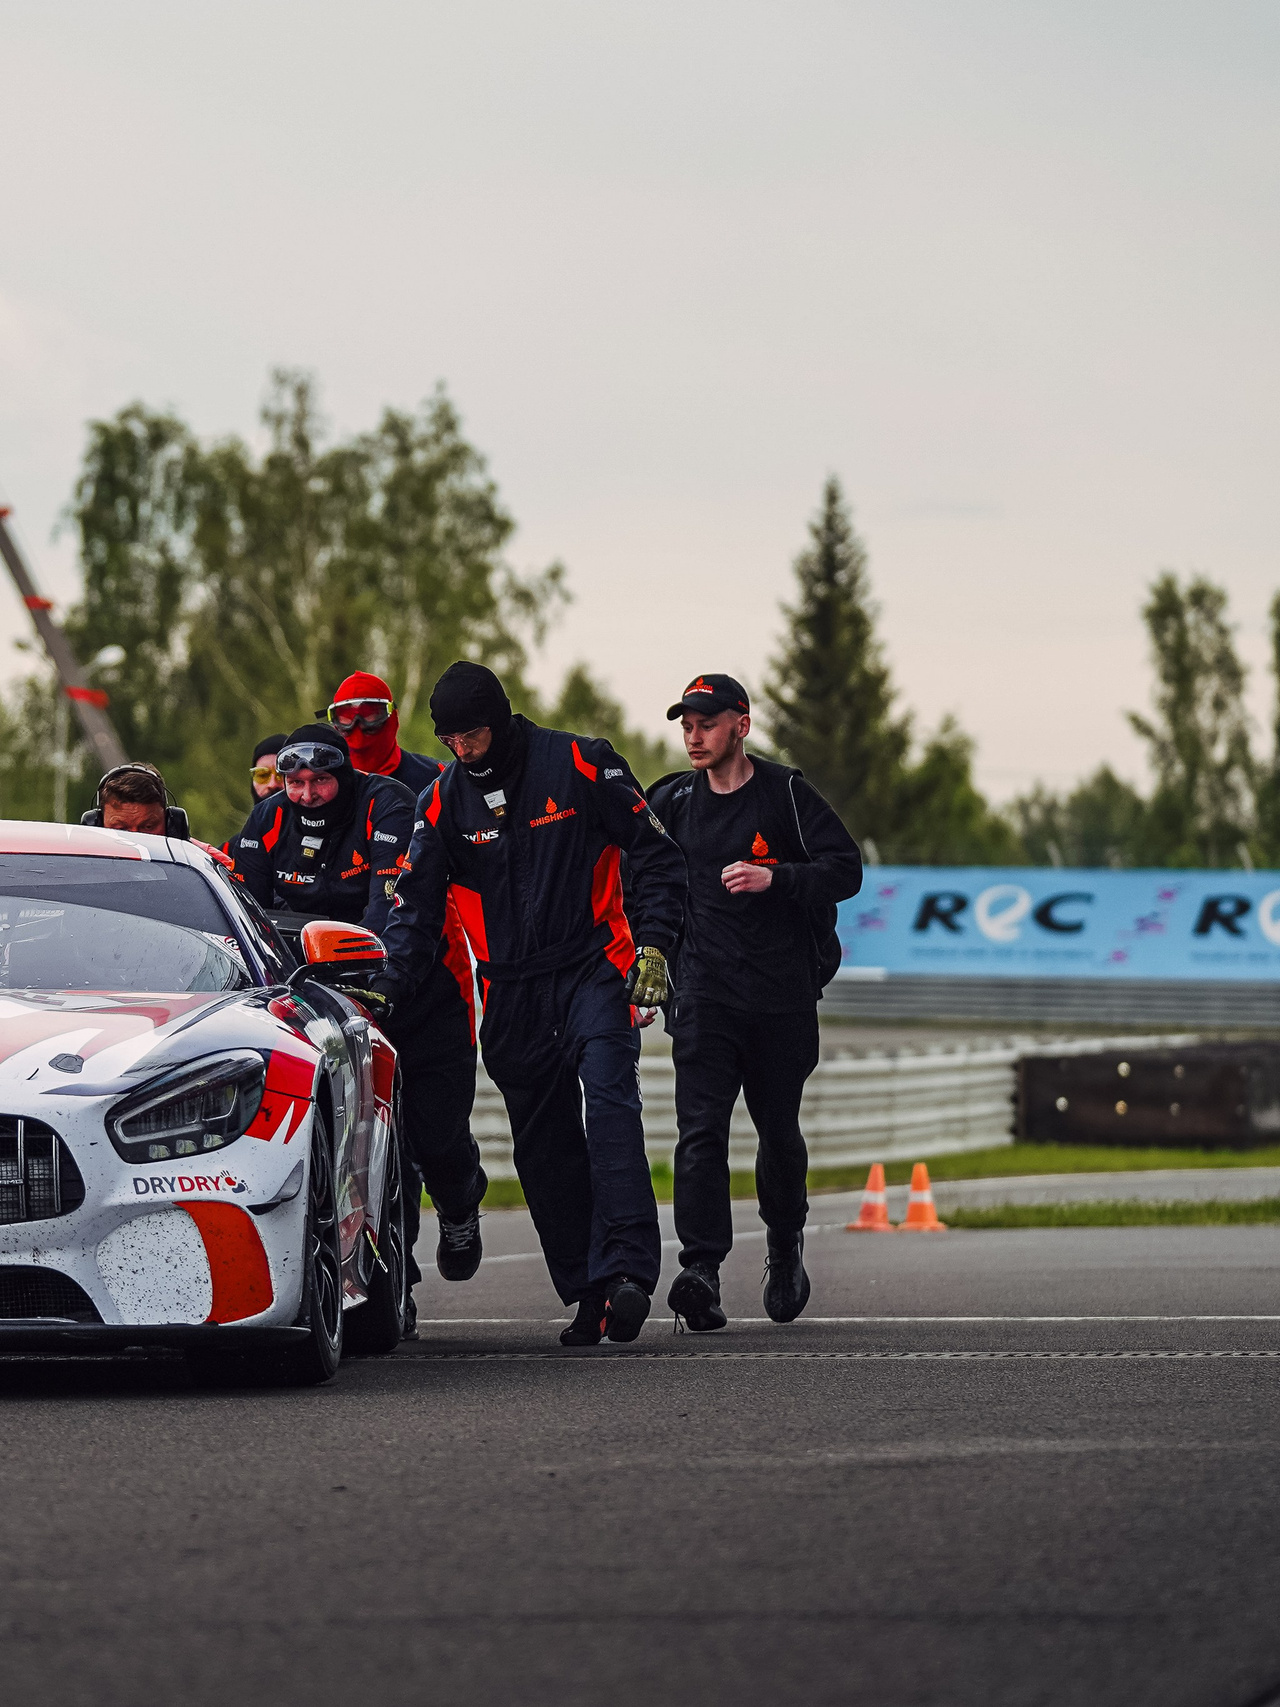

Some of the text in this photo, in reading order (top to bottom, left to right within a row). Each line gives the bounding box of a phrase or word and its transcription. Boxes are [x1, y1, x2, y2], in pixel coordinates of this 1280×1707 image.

[529, 808, 577, 828] SHISHKOIL
[276, 870, 316, 883] TWINS
[132, 1176, 221, 1195] DRYDRY
